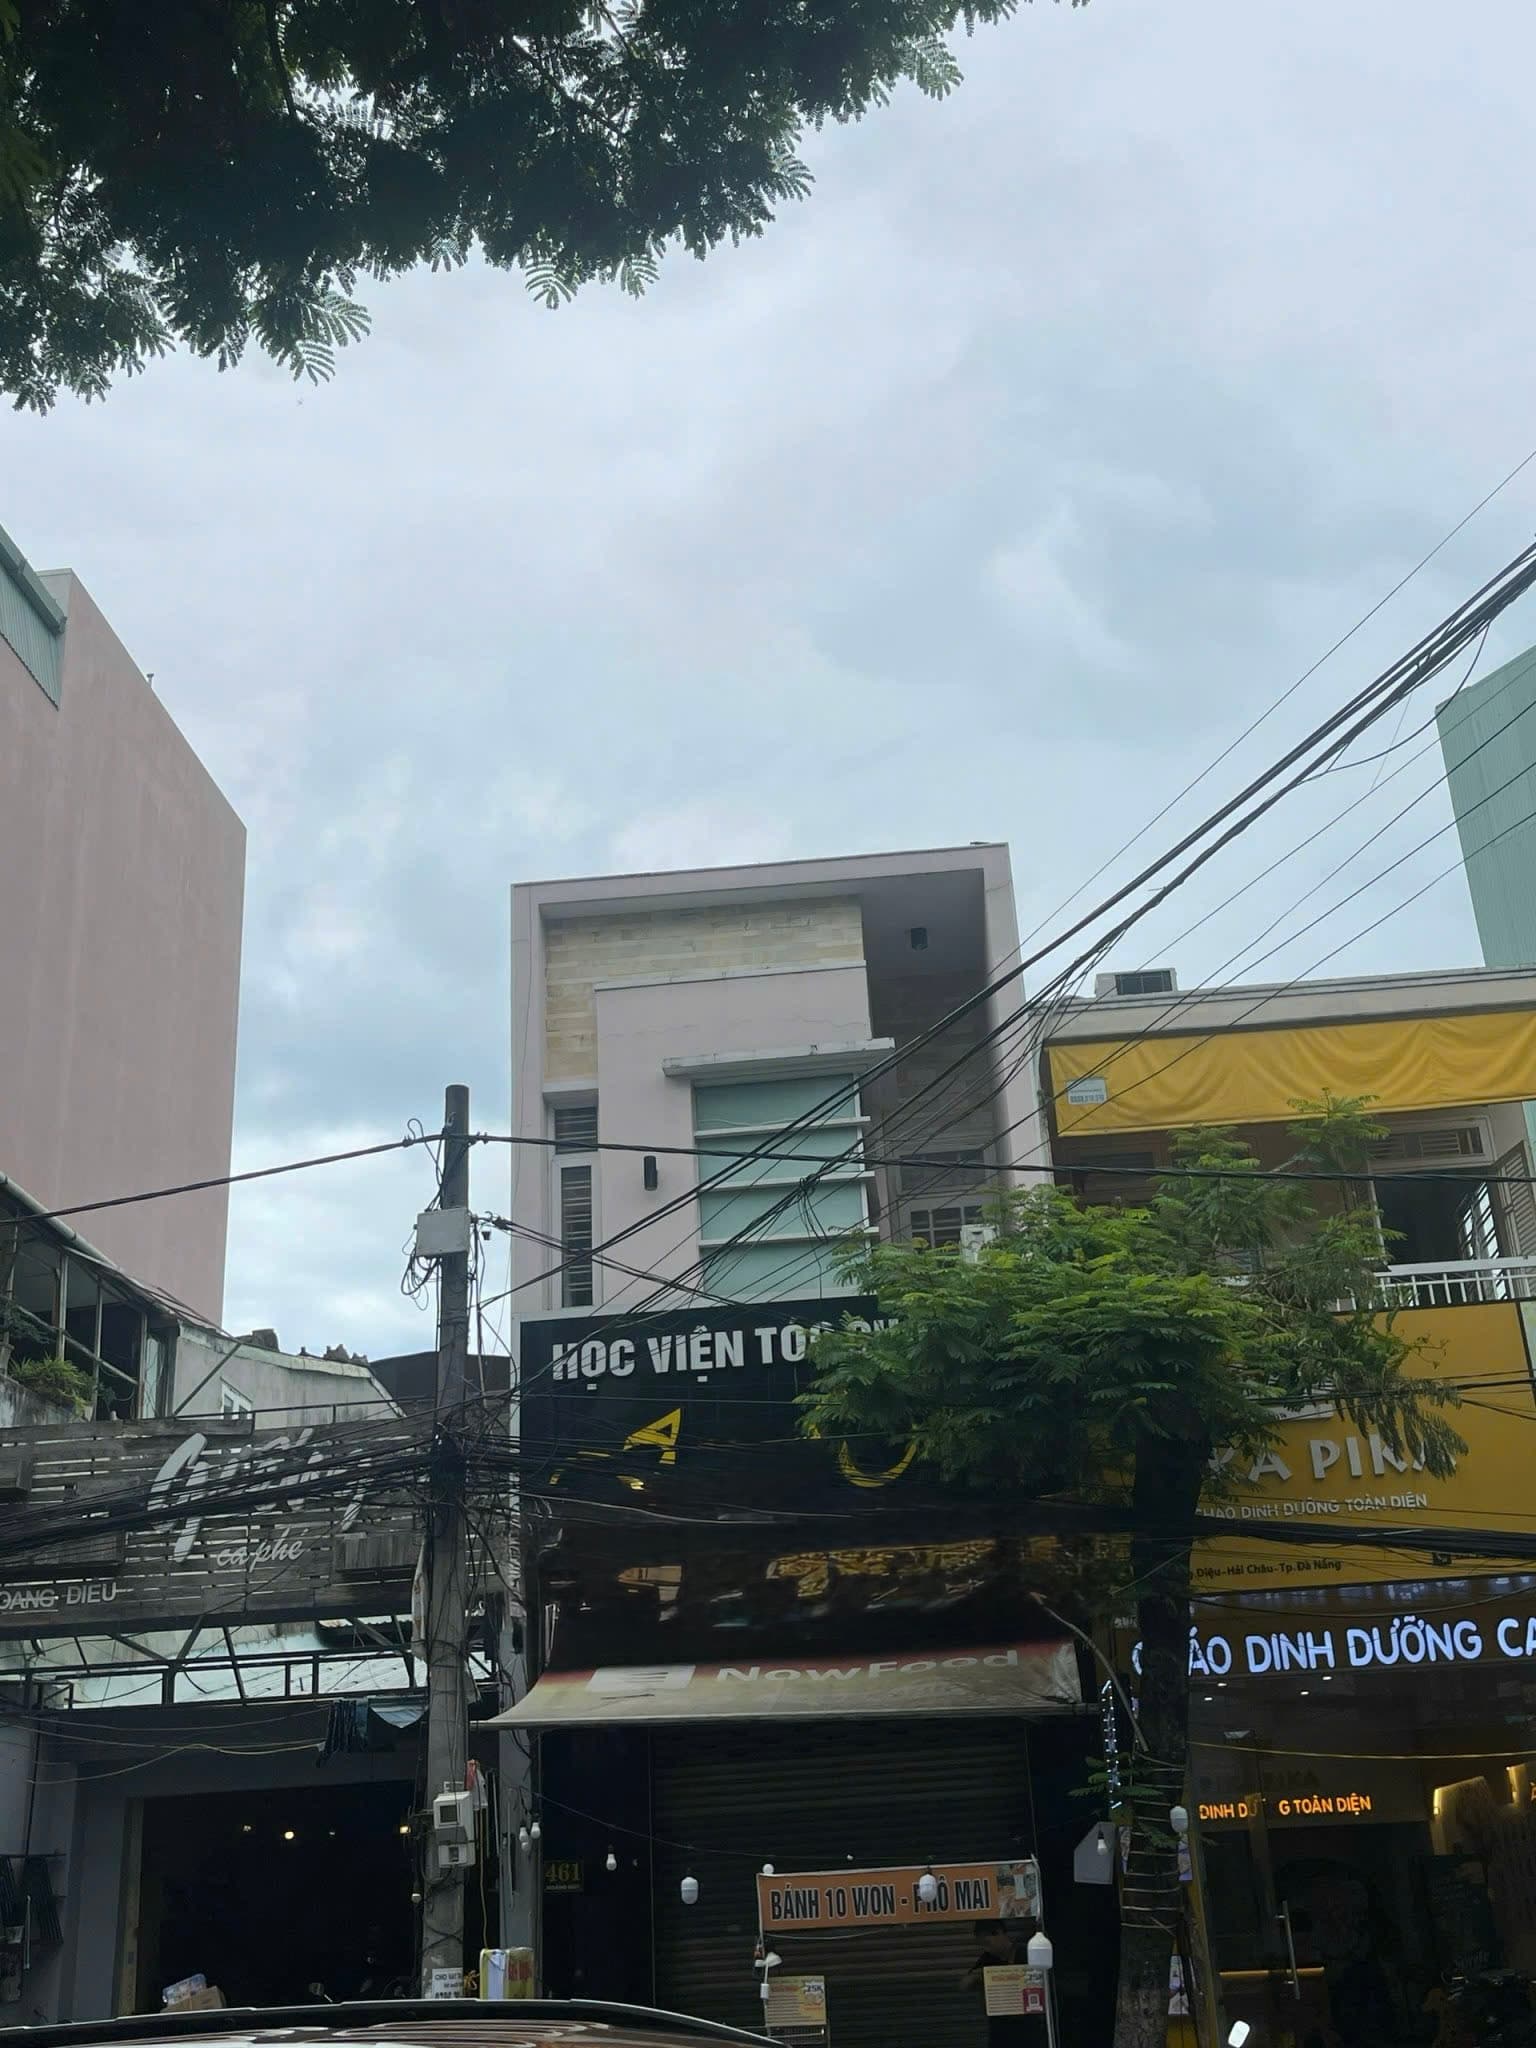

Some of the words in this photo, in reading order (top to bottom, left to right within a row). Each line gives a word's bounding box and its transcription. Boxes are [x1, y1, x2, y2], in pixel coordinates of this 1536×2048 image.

[552, 1338, 635, 1390] HỌC
[648, 1325, 744, 1383] VIỆN
[1245, 1630, 1336, 1674] DINH
[1346, 1615, 1483, 1667] DƯỠNG
[1198, 1802, 1235, 1820] DINH
[1293, 1793, 1332, 1815] TOÀN
[1335, 1791, 1373, 1816] DIỆN
[545, 1862, 581, 1882] 461
[770, 1882, 820, 1921] BÁNH
[825, 1887, 847, 1918] 10
[852, 1885, 895, 1917] WON
[955, 1878, 991, 1911] MAI
